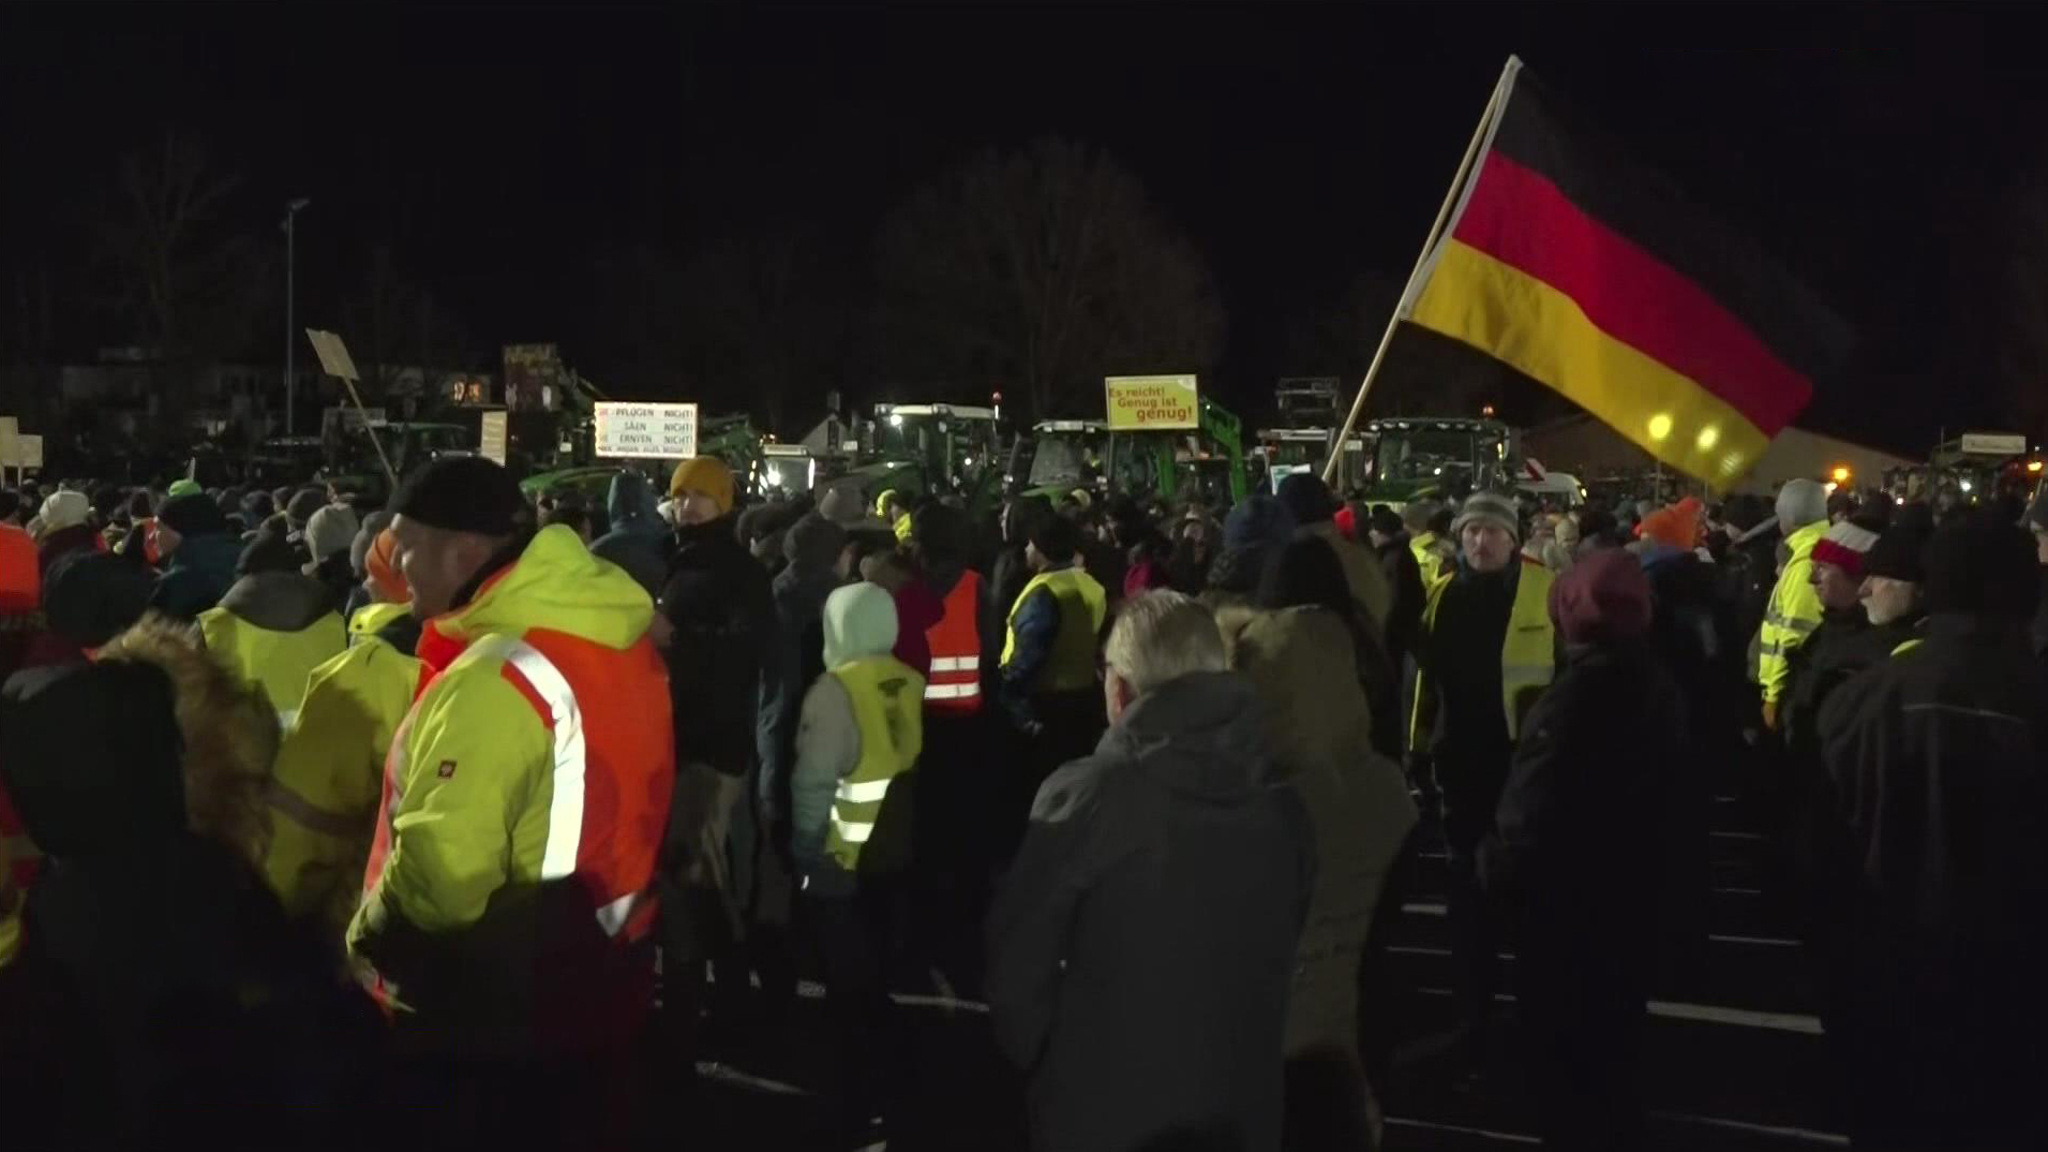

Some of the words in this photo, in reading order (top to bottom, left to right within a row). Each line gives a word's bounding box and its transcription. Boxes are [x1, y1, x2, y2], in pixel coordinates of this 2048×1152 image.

[1109, 388, 1122, 397] Es
[1126, 387, 1165, 397] reicht!
[1118, 398, 1157, 409] Genug
[1162, 397, 1177, 407] ist
[1137, 405, 1192, 422] genug!
